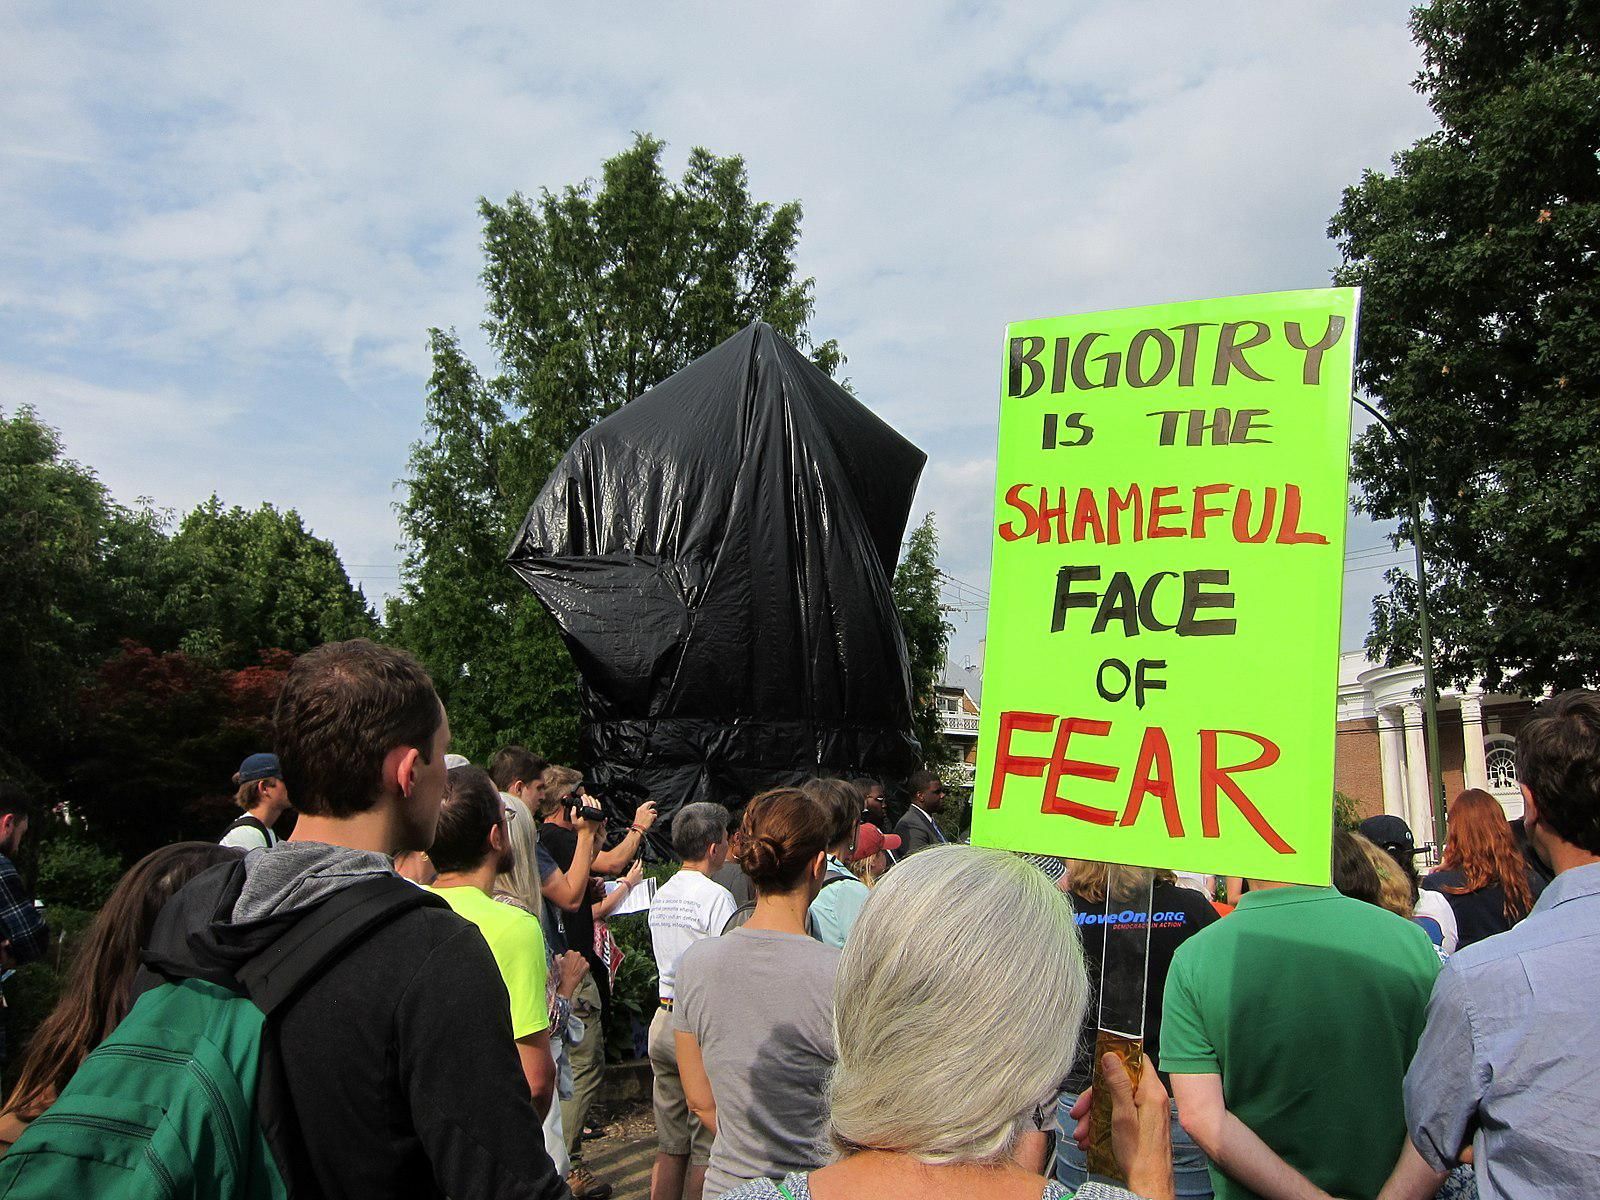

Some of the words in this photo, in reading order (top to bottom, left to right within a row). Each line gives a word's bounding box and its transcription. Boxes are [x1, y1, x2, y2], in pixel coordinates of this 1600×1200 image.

[1008, 315, 1345, 398] BIGOTRY
[1042, 413, 1094, 449] IS
[1146, 408, 1273, 446] THE
[998, 483, 1330, 545] SHAMEFUL
[1051, 565, 1237, 637] FACE
[1096, 658, 1168, 710] OF
[987, 711, 1297, 854] FEAR
